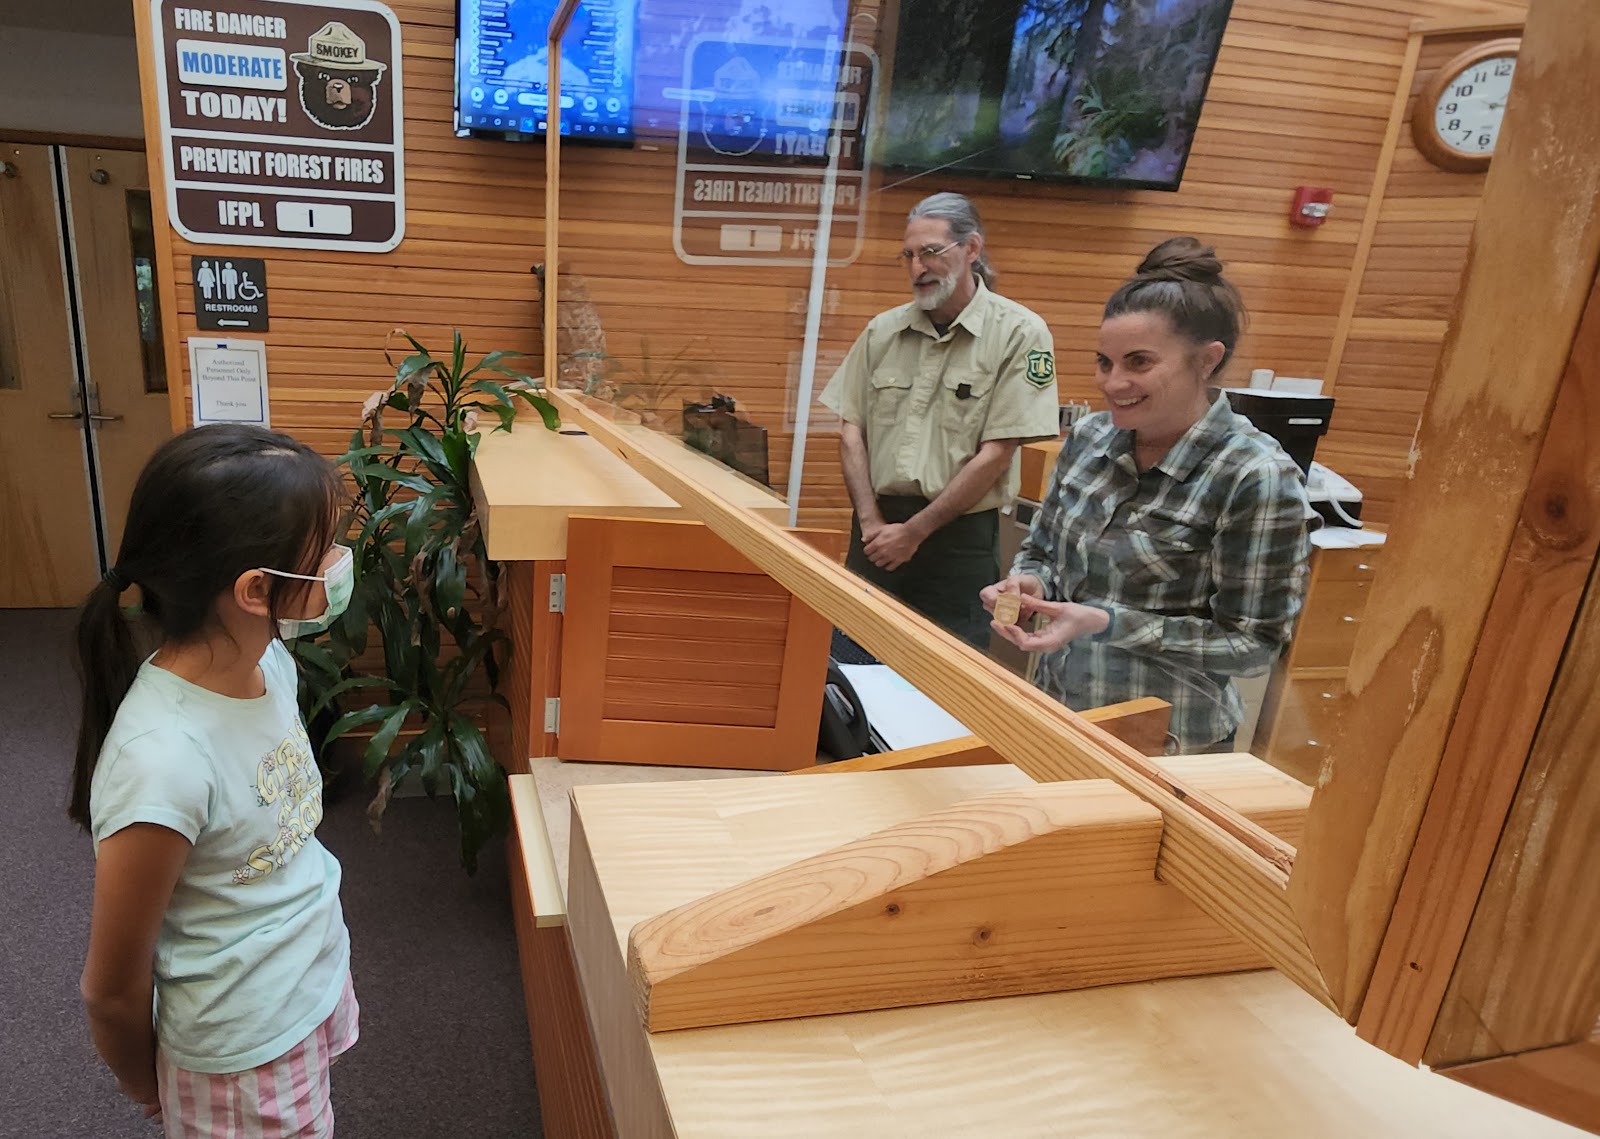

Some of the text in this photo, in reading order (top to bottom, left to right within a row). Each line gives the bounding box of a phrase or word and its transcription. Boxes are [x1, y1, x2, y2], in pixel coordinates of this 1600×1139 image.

[174, 7, 287, 39] FIRE DANGER
[316, 43, 359, 59] SMOKEY
[182, 51, 283, 80] MODERATE
[1493, 64, 1512, 76] 12
[1474, 72, 1487, 83] 11
[1455, 85, 1473, 97] 10
[180, 90, 287, 123] TODAY!
[1445, 103, 1458, 114] 9
[1448, 119, 1461, 131] 8
[1462, 130, 1473, 141] 7
[1478, 134, 1491, 146] 6
[180, 145, 384, 184] PREVENT FOREST FIRES
[218, 200, 264, 228] IFPL
[205, 303, 258, 313] RESTROOMS
[202, 374, 225, 382] Beyond
